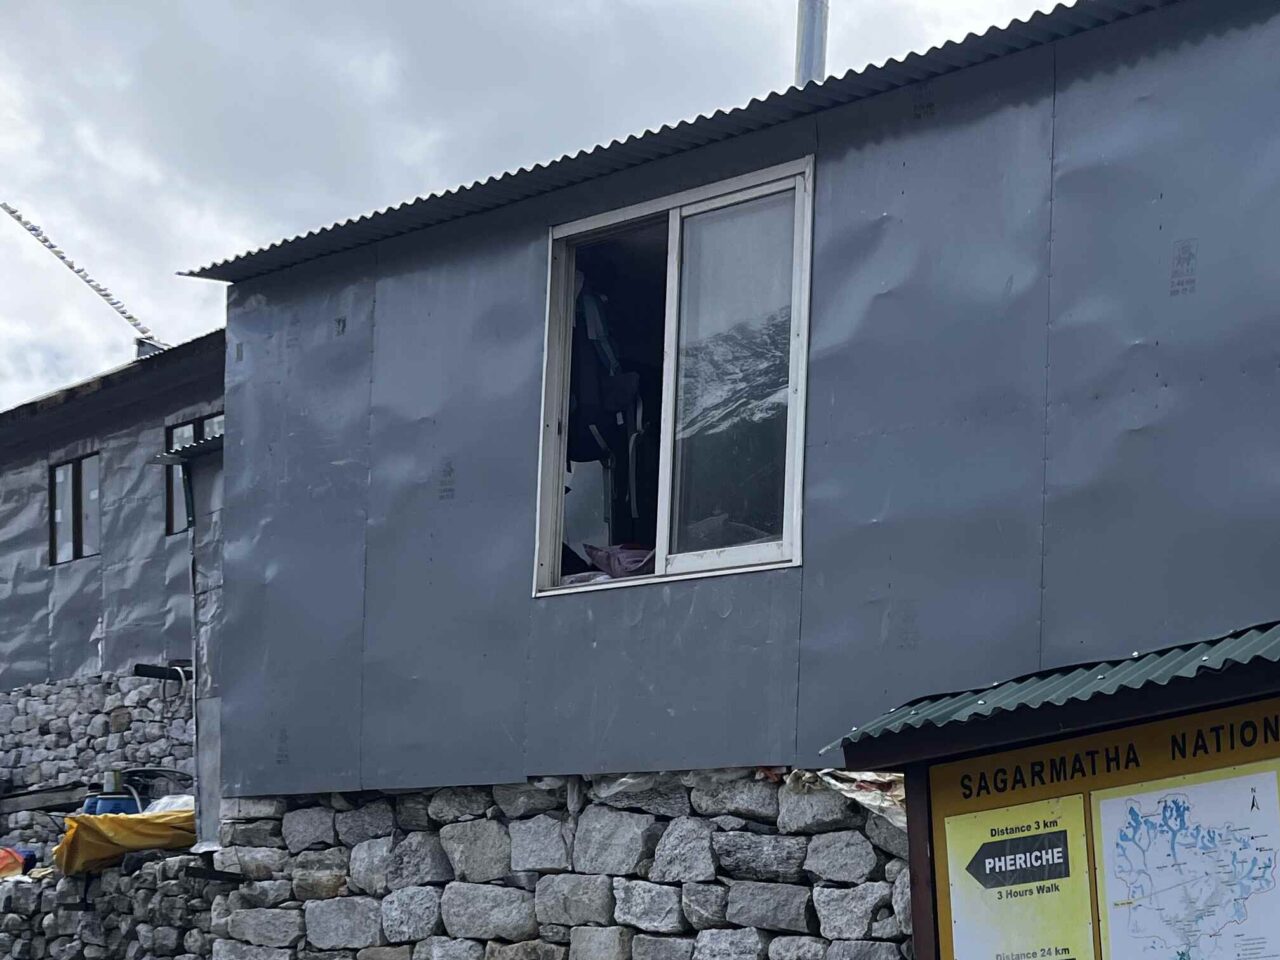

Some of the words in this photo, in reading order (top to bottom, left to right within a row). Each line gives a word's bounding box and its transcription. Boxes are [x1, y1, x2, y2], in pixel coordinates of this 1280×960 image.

[960, 743, 1141, 800] SAGARMATHA
[990, 824, 1031, 837] Distance
[1034, 821, 1041, 831] 3
[1043, 819, 1058, 829] km
[985, 848, 1064, 874] PHERICHE
[997, 890, 1003, 900] 3
[1006, 887, 1034, 899] Hours
[1036, 883, 1060, 895] Walk
[1040, 947, 1053, 958] 24
[1055, 946, 1070, 956] km
